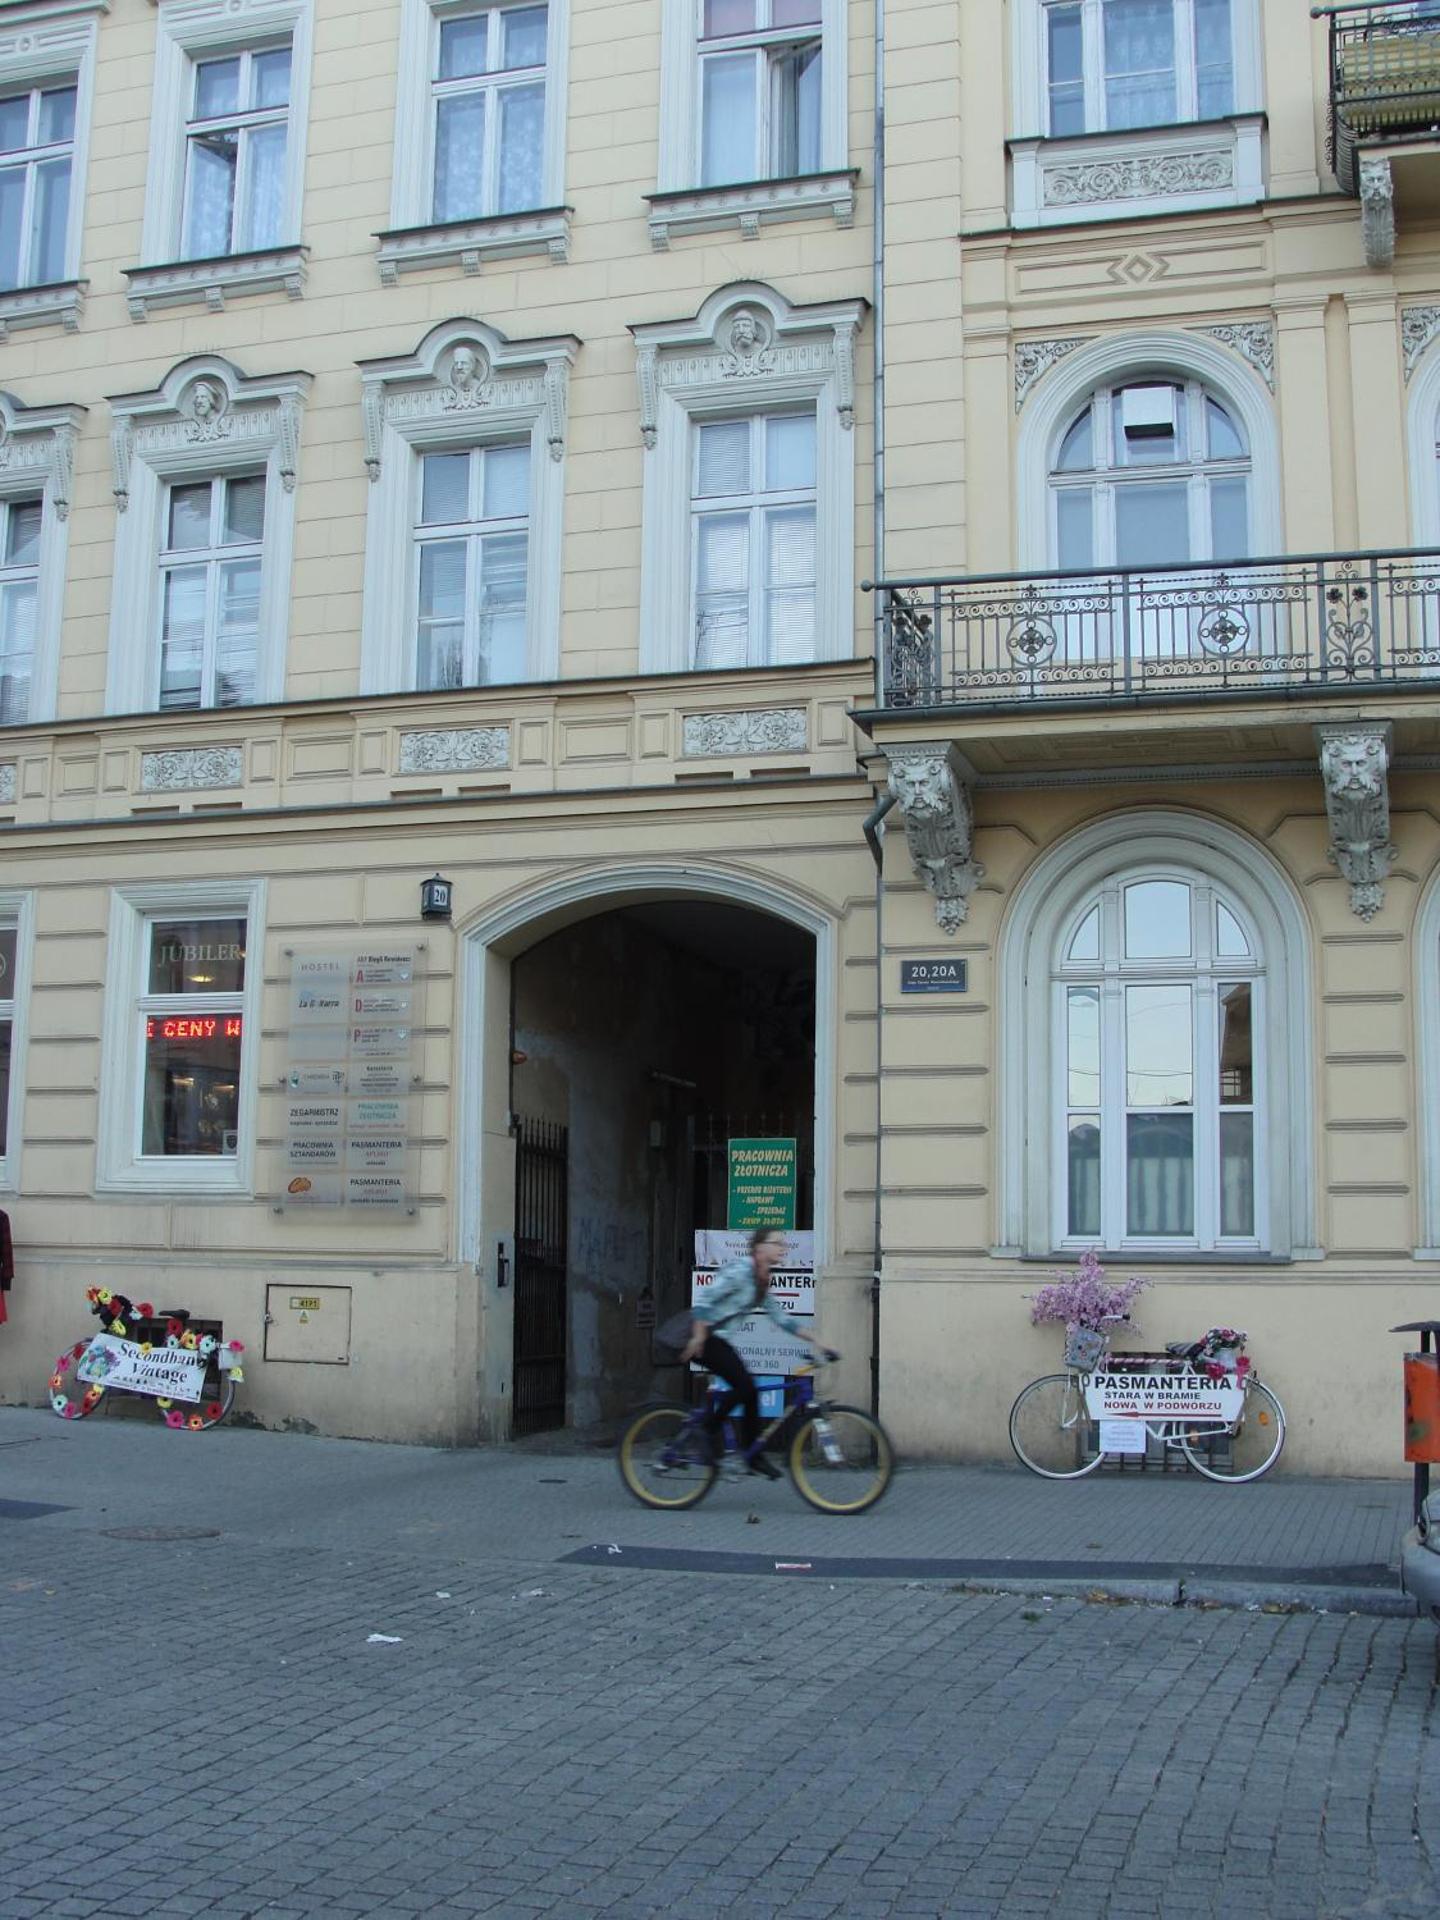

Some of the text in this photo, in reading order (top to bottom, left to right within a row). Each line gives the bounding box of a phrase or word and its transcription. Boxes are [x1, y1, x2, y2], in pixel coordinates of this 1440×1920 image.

[435, 888, 446, 903] 20
[161, 944, 242, 965] JUBILER
[164, 1020, 216, 1037] CENY
[351, 1141, 402, 1149] PASMANTERIA
[731, 1150, 793, 1162] PRACOWNIA
[734, 1165, 788, 1177] ZŁOTNICZA
[350, 1178, 401, 1186] PASMANTERIA
[133, 1362, 188, 1385] Vintage
[1095, 1376, 1231, 1390] PASMANTERIA
[1105, 1392, 1141, 1400] STARA
[1158, 1392, 1200, 1400] BRAMIE
[1104, 1401, 1137, 1409] NOWA
